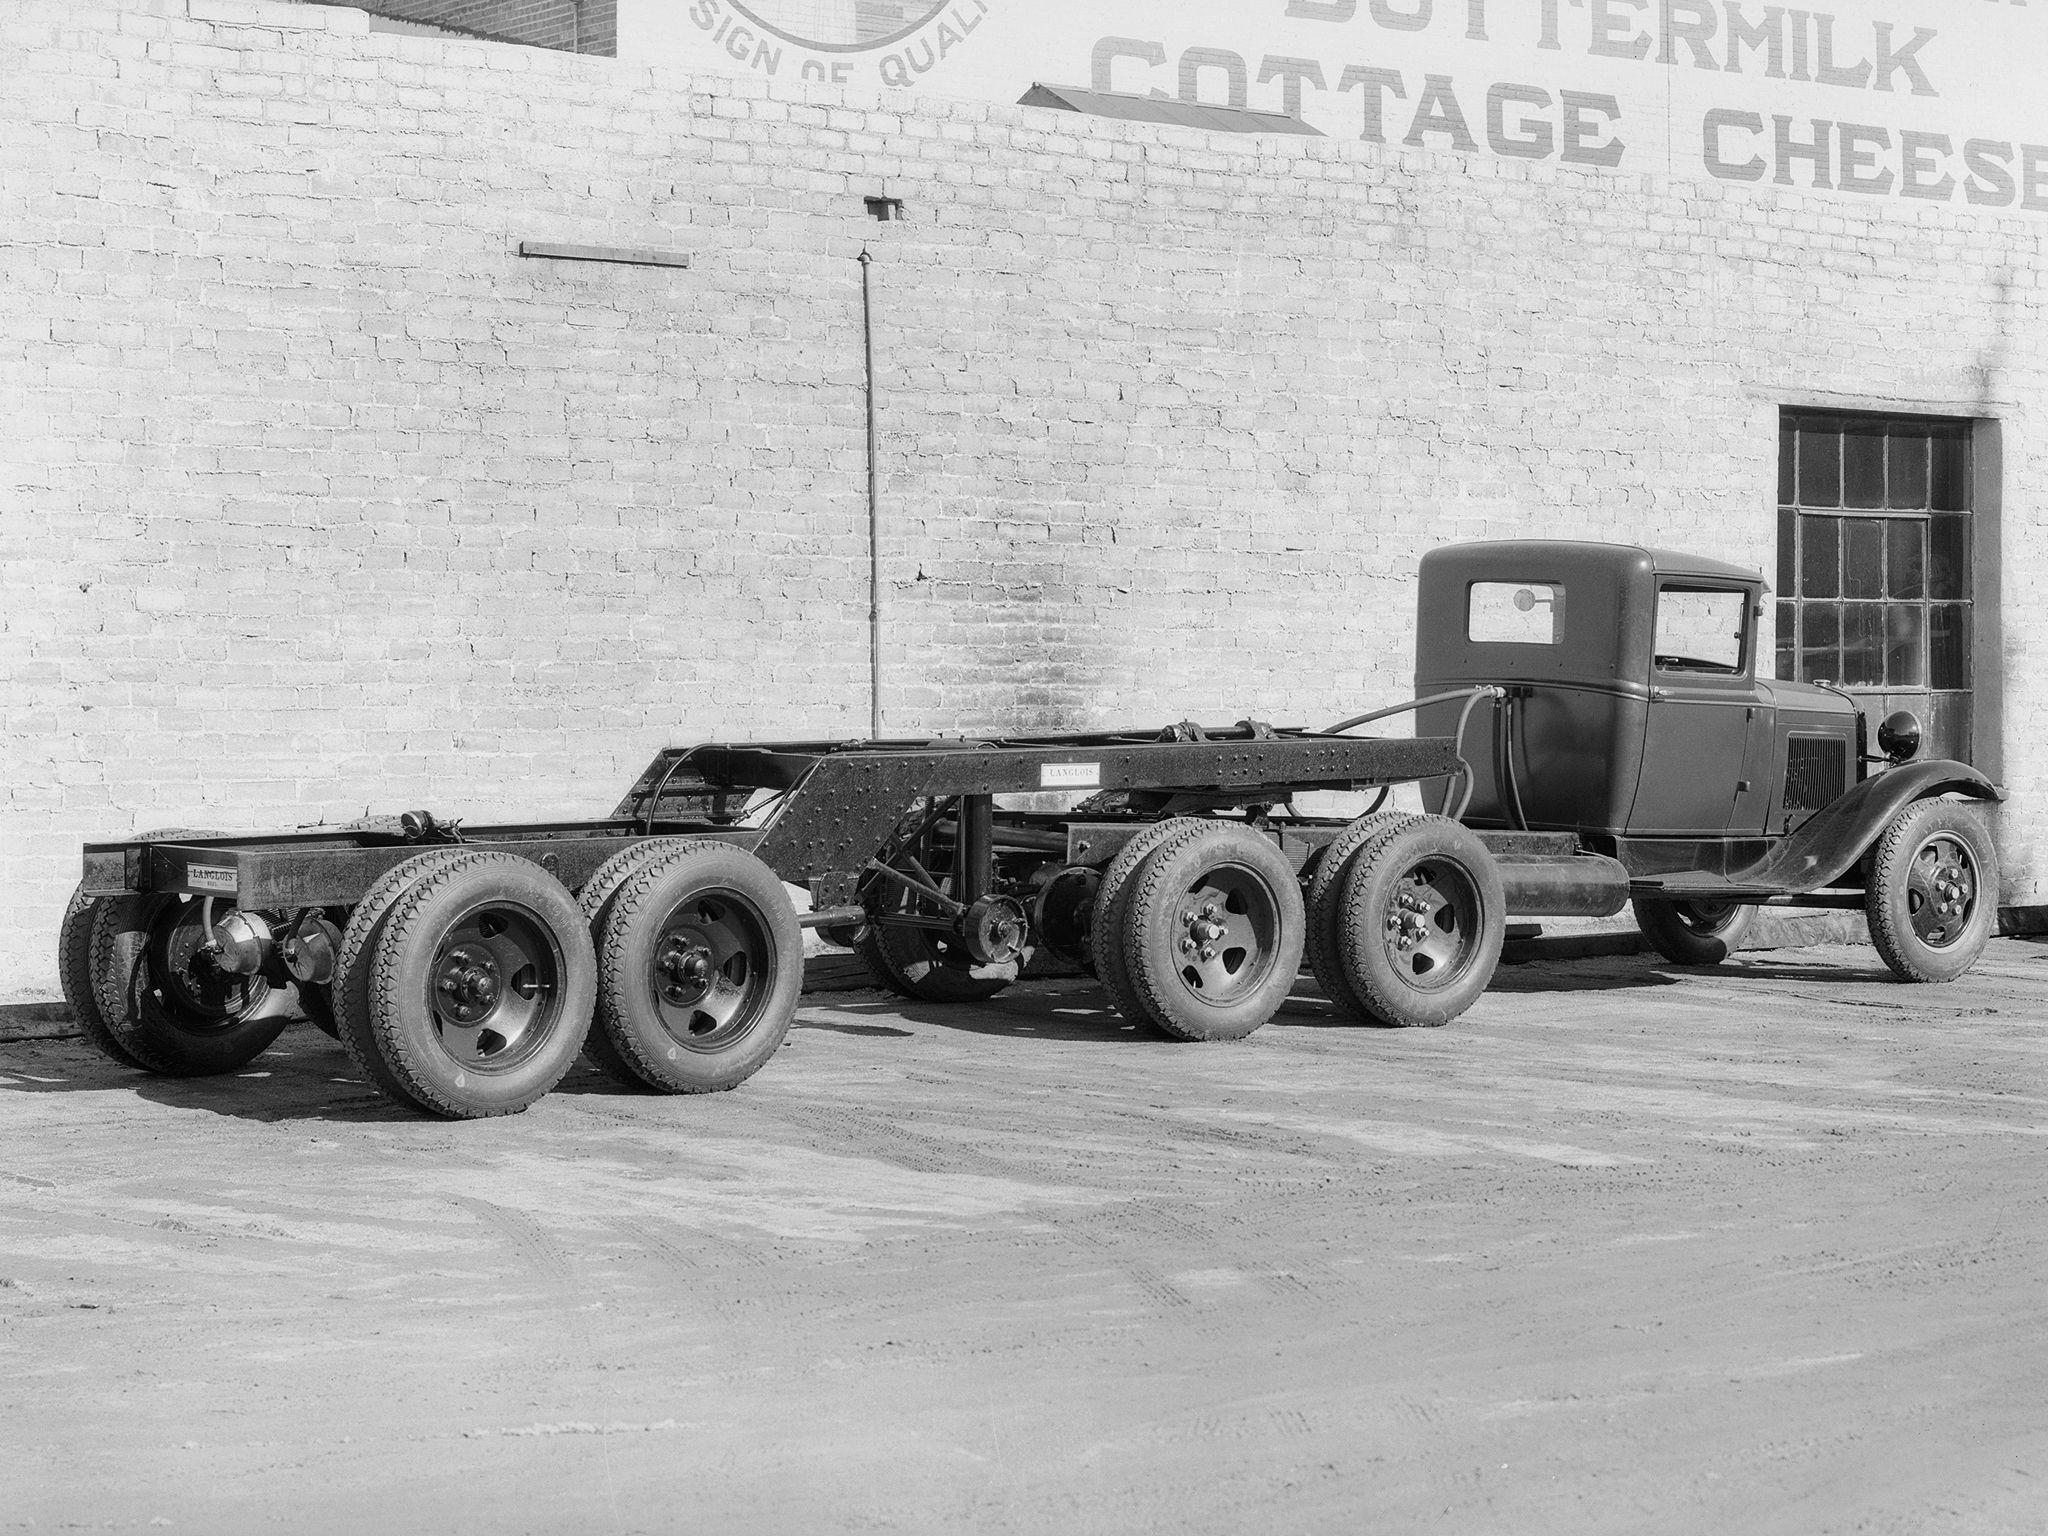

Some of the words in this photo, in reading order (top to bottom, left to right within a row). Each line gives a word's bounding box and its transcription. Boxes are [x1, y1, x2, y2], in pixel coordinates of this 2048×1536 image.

[689, 0, 782, 75] SIGN
[801, 59, 854, 83] OF
[1285, 0, 1940, 98] TERMILK
[1091, 35, 1626, 168] COTTAGE
[1049, 768, 1094, 777] LANGLOIS
[193, 869, 233, 881] LANGLOIS
